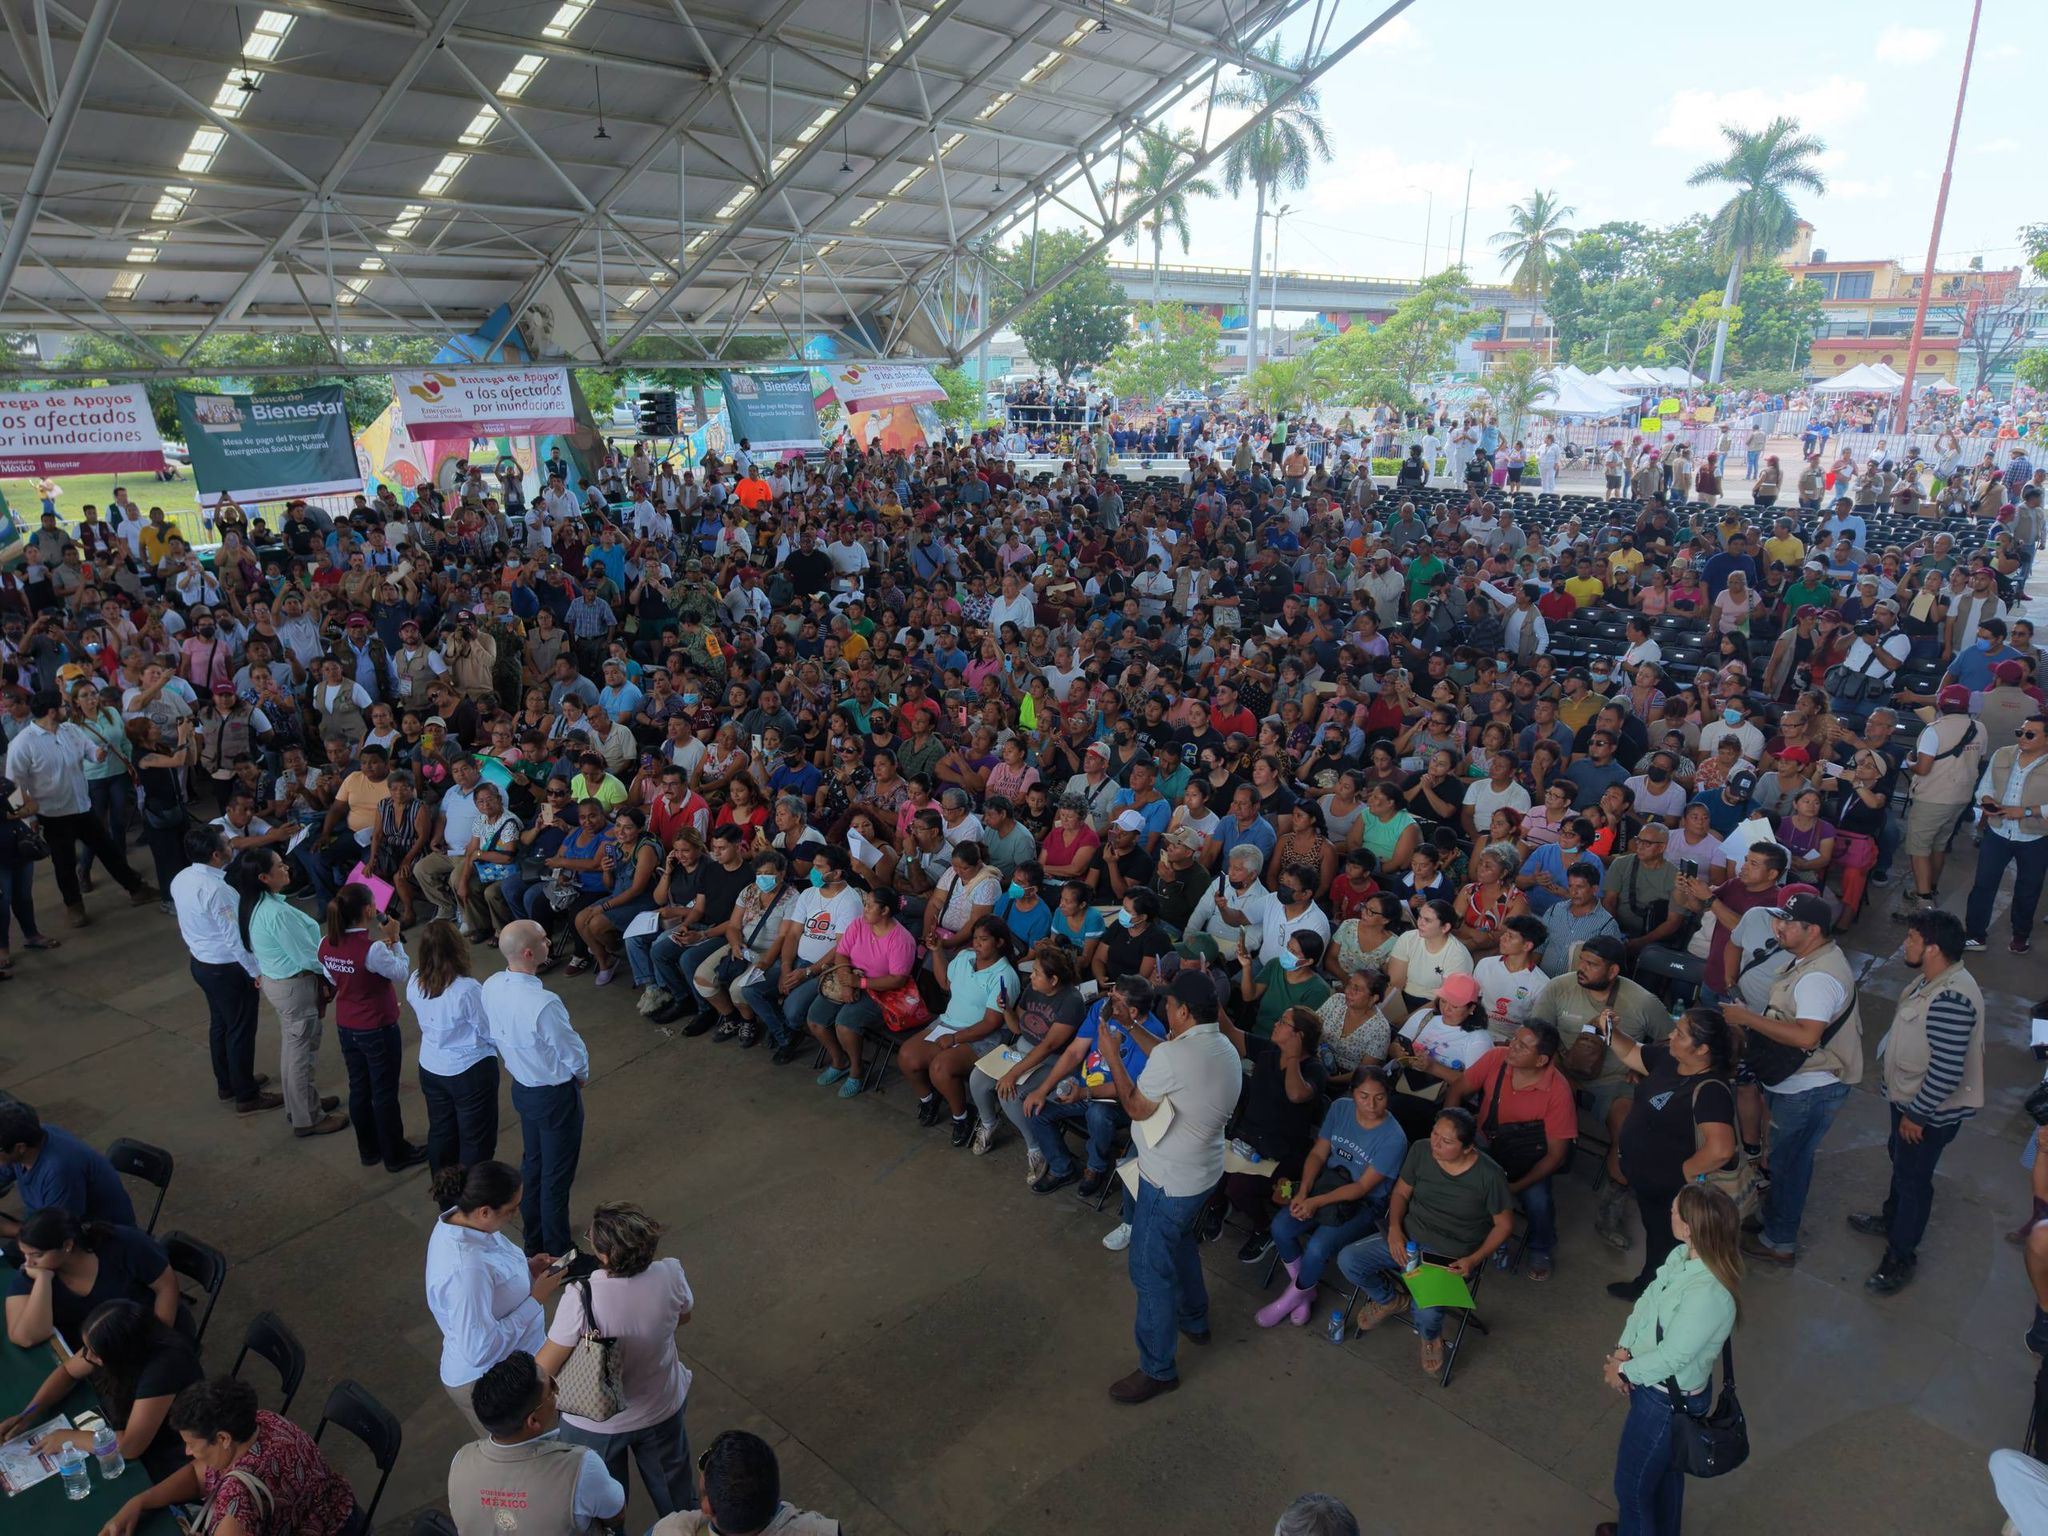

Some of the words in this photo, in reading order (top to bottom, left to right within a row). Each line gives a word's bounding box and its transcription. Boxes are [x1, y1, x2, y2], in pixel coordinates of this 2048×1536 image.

[460, 375, 504, 386] Entrega
[507, 374, 519, 382] de
[524, 371, 560, 384] Apoyos
[465, 390, 473, 399] a
[478, 386, 498, 399] los
[501, 383, 562, 401] afectados
[763, 381, 810, 392] Bienestar
[0, 400, 39, 411] rega
[46, 396, 66, 407] de
[73, 394, 133, 409] Apoyos
[251, 394, 285, 405] Banco
[287, 393, 304, 402] del
[251, 401, 343, 420] Bienestar
[473, 403, 493, 416] por
[496, 399, 565, 412] inundaciones
[34, 409, 137, 432] afectados
[0, 435, 15, 447] or
[22, 428, 141, 446] inundaciones
[222, 437, 243, 446] Mesa
[244, 437, 254, 446] de
[256, 436, 274, 447] pago
[275, 433, 288, 443] del
[289, 431, 325, 444] Programa
[224, 446, 270, 457] Emergencia
[271, 443, 294, 453] Social
[302, 441, 329, 450] Natural
[1, 462, 36, 473] México
[44, 460, 80, 469] Bienestar
[324, 955, 345, 964] Gobierno
[325, 961, 354, 973] México
[480, 1497, 529, 1509] MÉXICO
